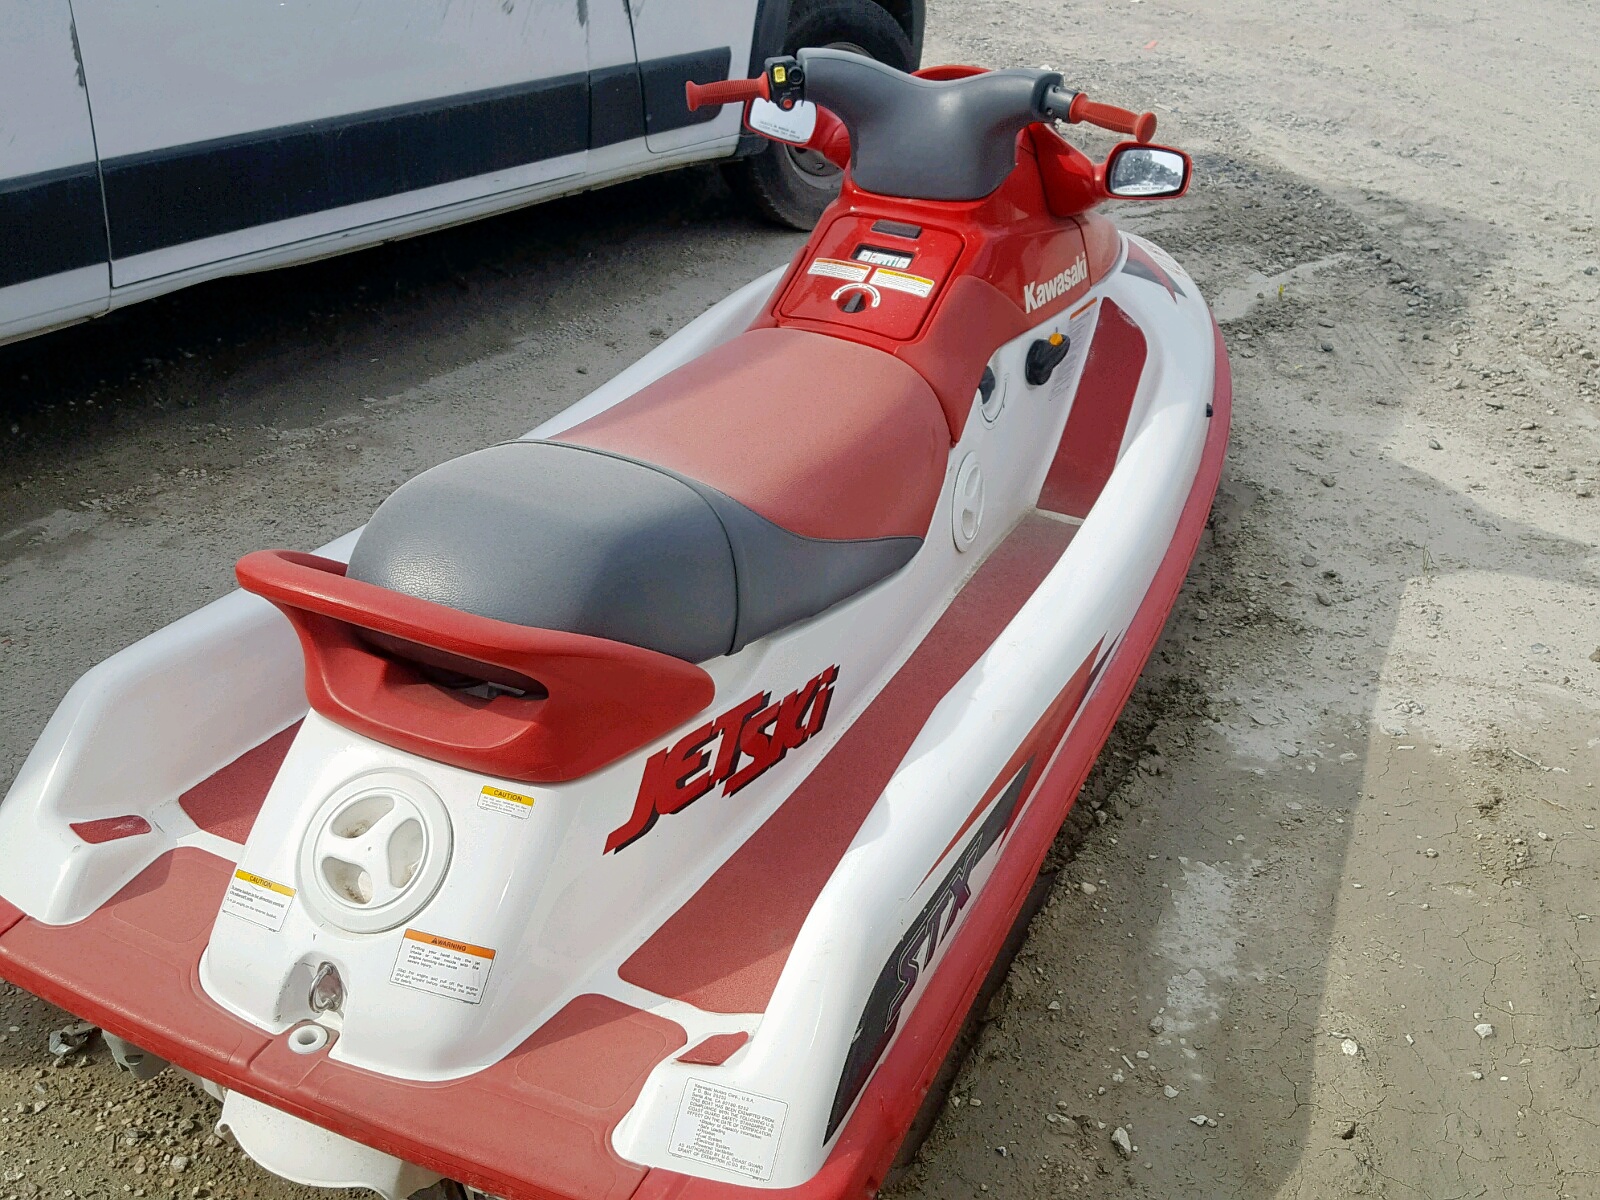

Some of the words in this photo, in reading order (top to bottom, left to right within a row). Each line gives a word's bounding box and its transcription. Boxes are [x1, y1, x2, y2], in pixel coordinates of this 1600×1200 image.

[1023, 251, 1088, 314] Kawasaki
[493, 790, 523, 802] CAUTION
[249, 875, 273, 889] CAUTION
[884, 831, 983, 1034] STX
[437, 939, 467, 952] WARNING
